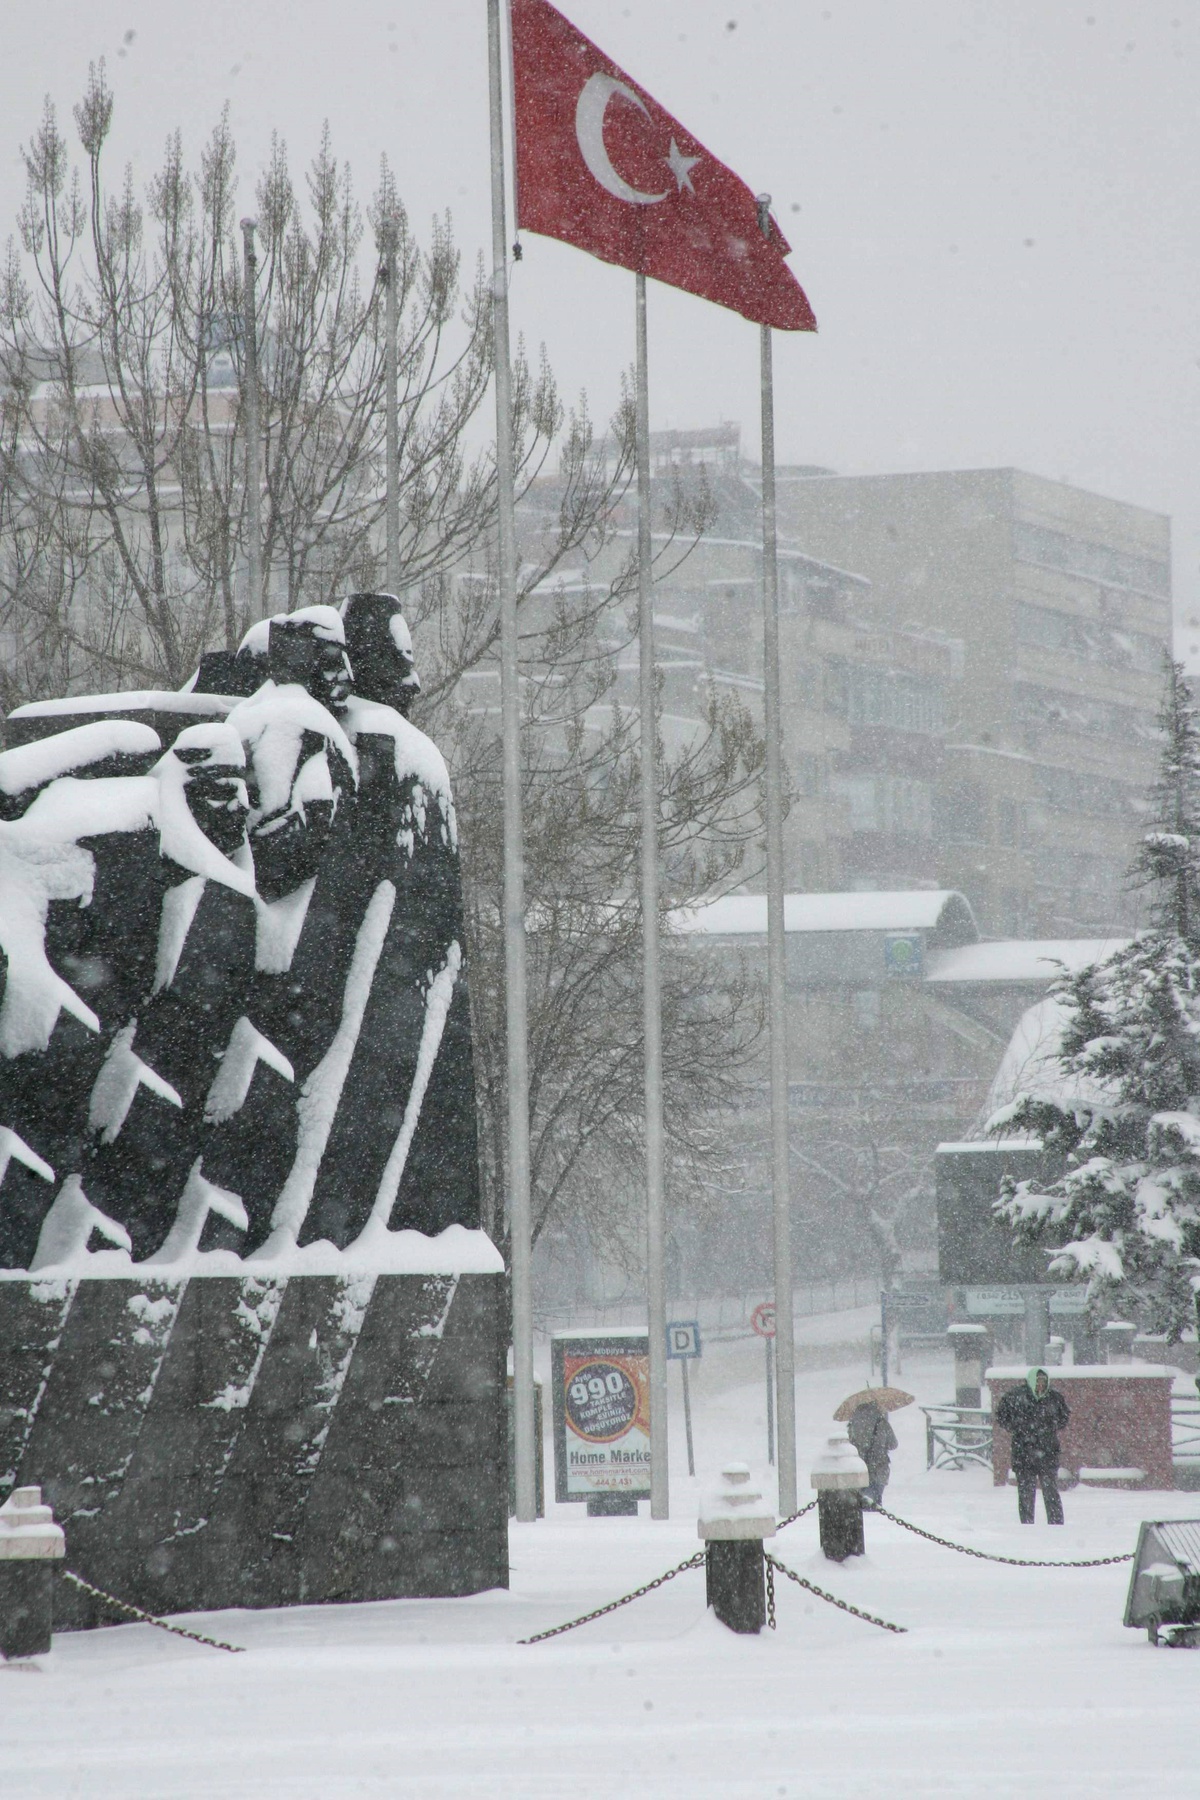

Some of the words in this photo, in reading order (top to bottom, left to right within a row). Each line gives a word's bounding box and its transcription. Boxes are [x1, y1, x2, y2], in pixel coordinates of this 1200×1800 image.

[675, 1331, 690, 1350] D
[571, 1372, 623, 1405] 990
[580, 1403, 612, 1419] KOMPLE
[570, 1451, 605, 1464] Home
